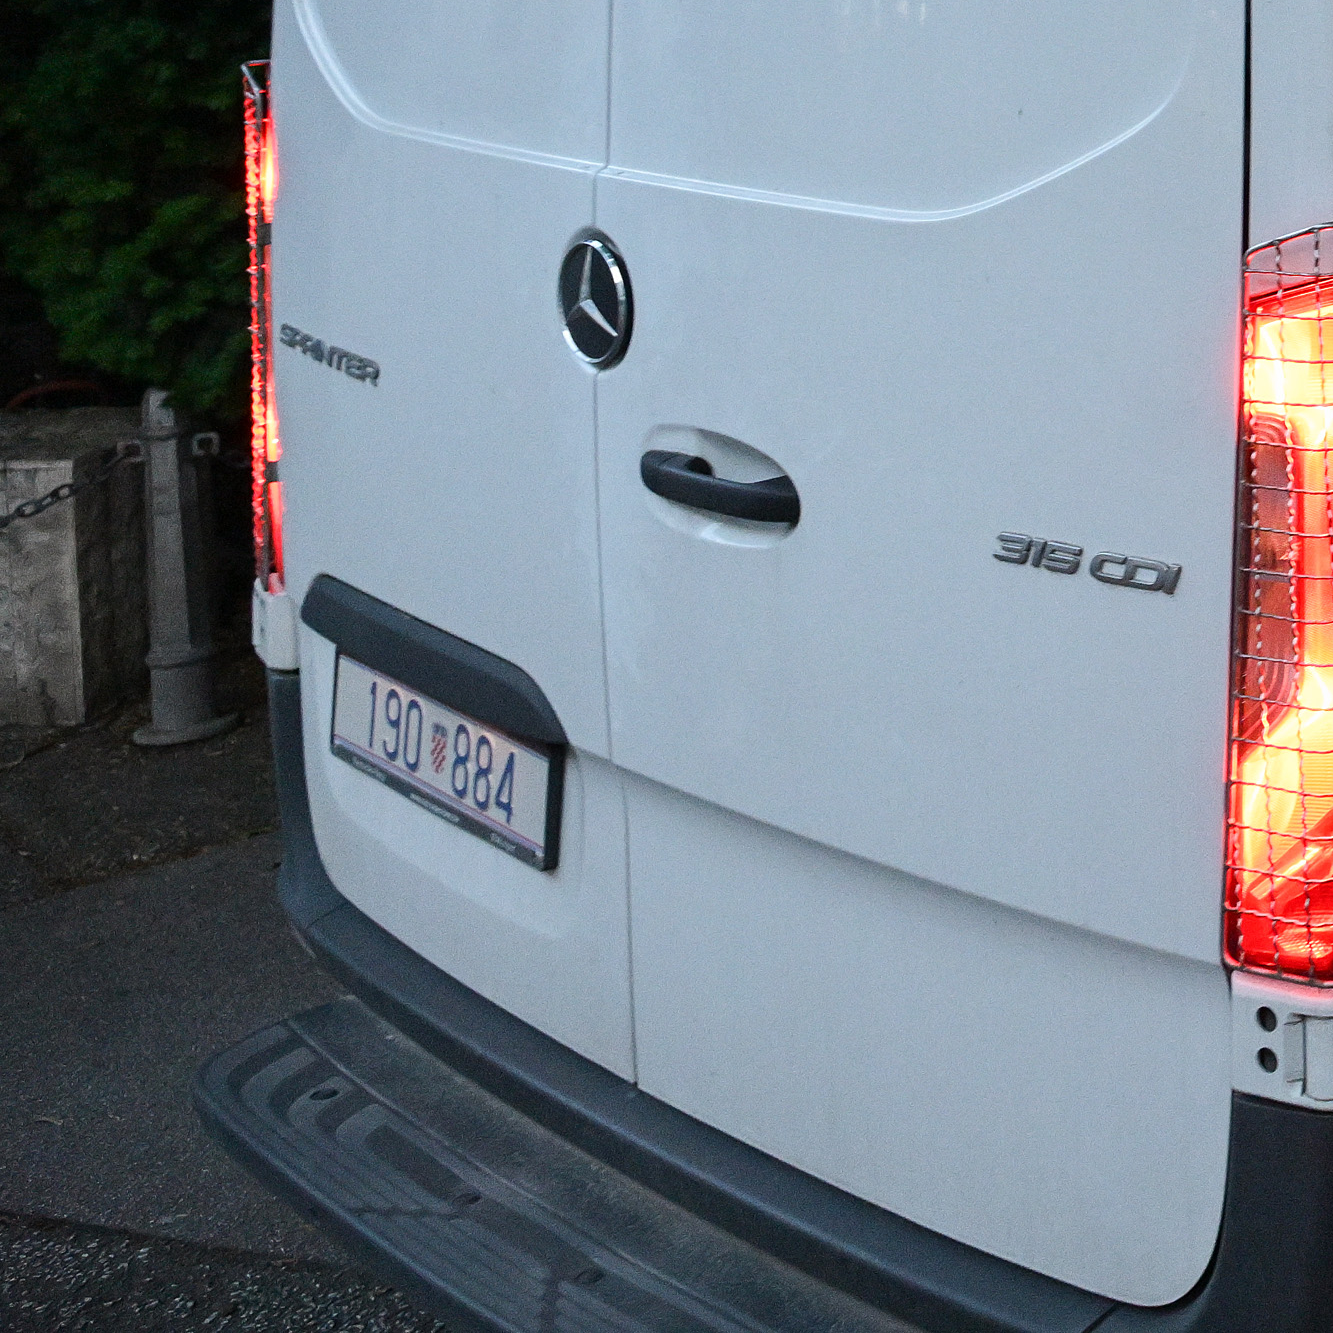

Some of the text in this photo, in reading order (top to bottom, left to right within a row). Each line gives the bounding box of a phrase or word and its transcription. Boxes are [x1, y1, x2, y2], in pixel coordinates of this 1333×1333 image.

[992, 531, 1182, 595] 315 CDI
[370, 681, 516, 825] 190 884
